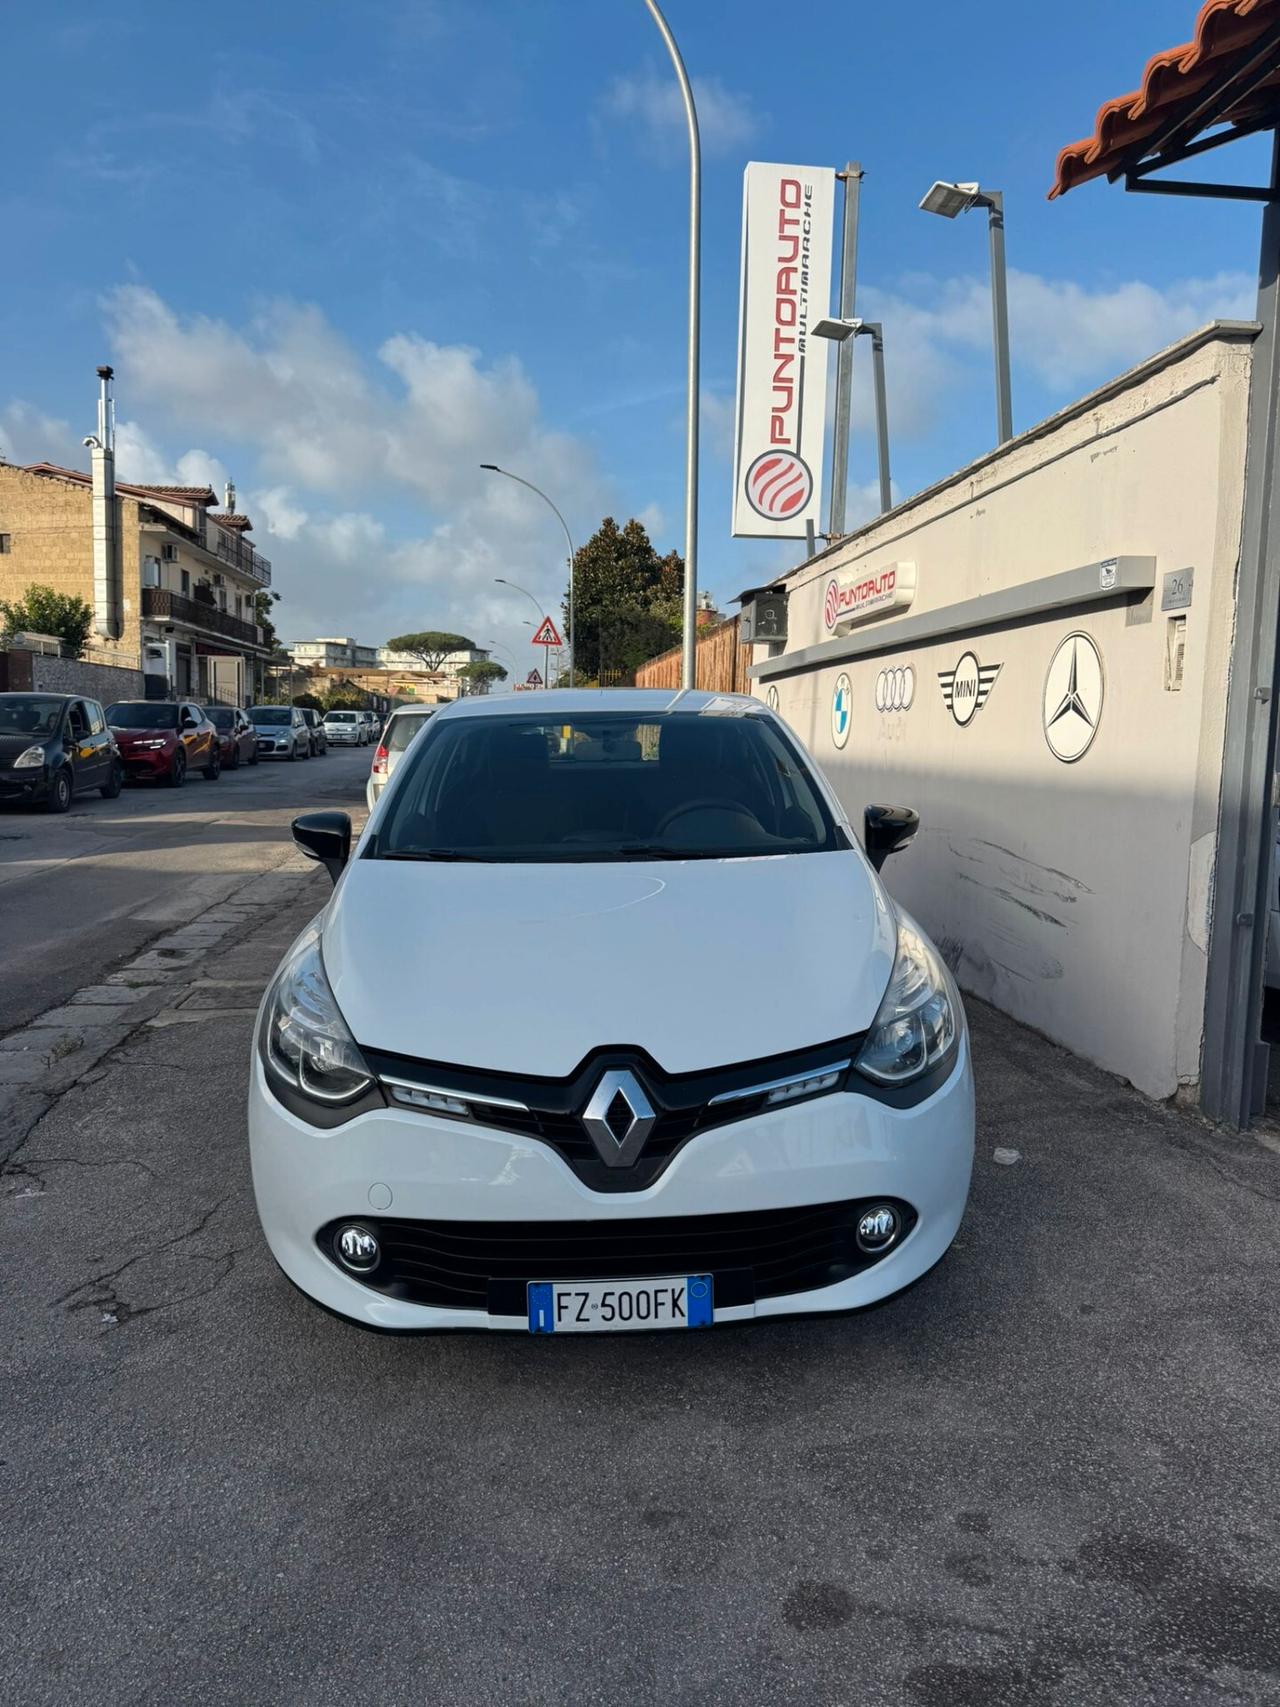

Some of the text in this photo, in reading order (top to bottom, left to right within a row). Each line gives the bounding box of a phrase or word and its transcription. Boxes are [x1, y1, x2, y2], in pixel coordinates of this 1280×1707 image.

[798, 184, 813, 353] MULTIMARCHE
[770, 178, 802, 444] PUNTOAUTO
[839, 570, 896, 606] PUNTOAUTO
[1171, 577, 1184, 596] 26
[954, 679, 977, 698] MINI
